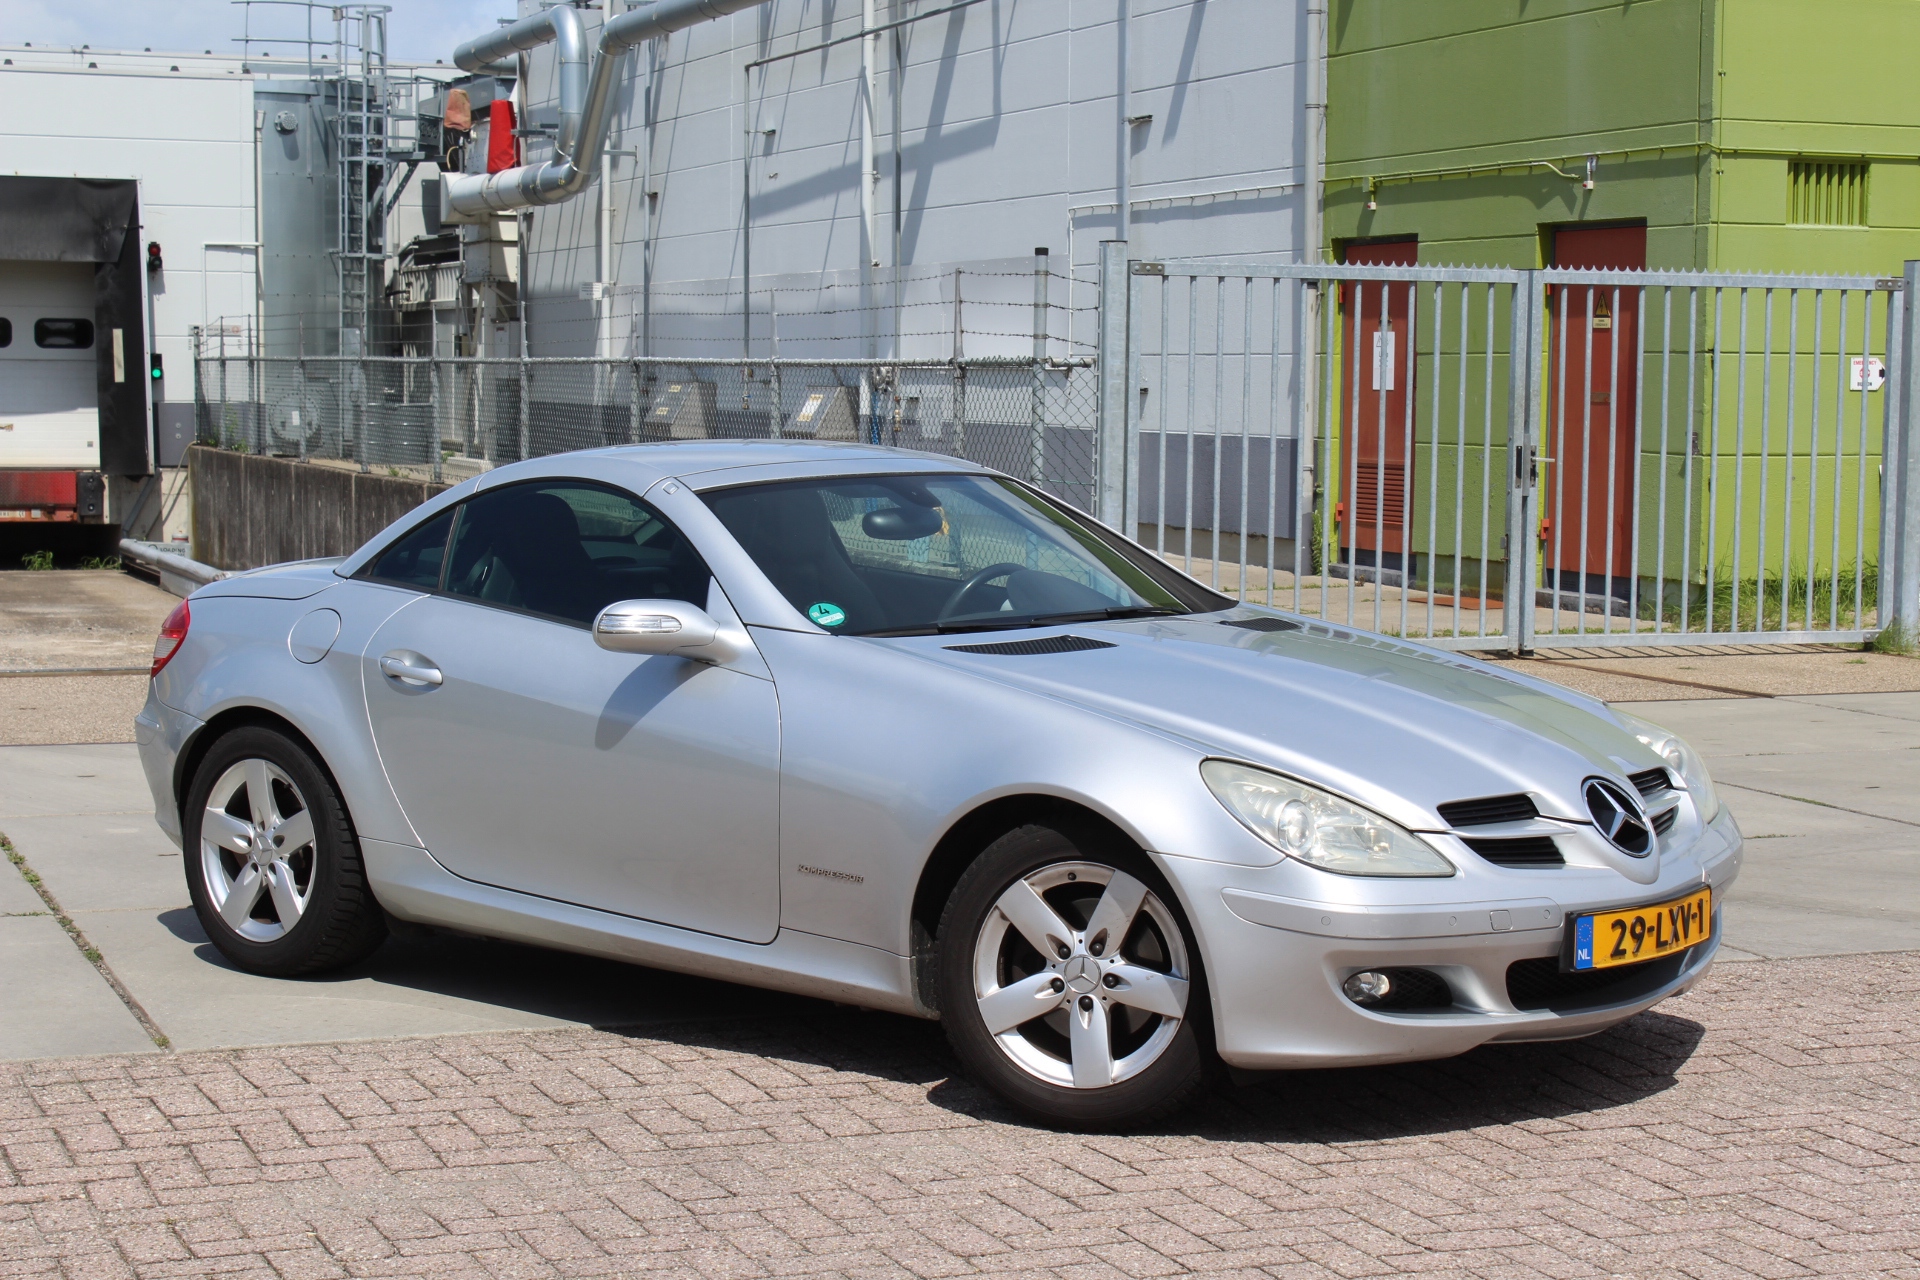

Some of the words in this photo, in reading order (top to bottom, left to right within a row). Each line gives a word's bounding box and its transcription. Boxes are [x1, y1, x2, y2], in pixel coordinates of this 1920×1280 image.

[818, 604, 830, 615] 4
[798, 864, 864, 883] KOMPRESSOR
[1610, 898, 1704, 959] 29-LXV-1
[1577, 948, 1591, 961] NL
